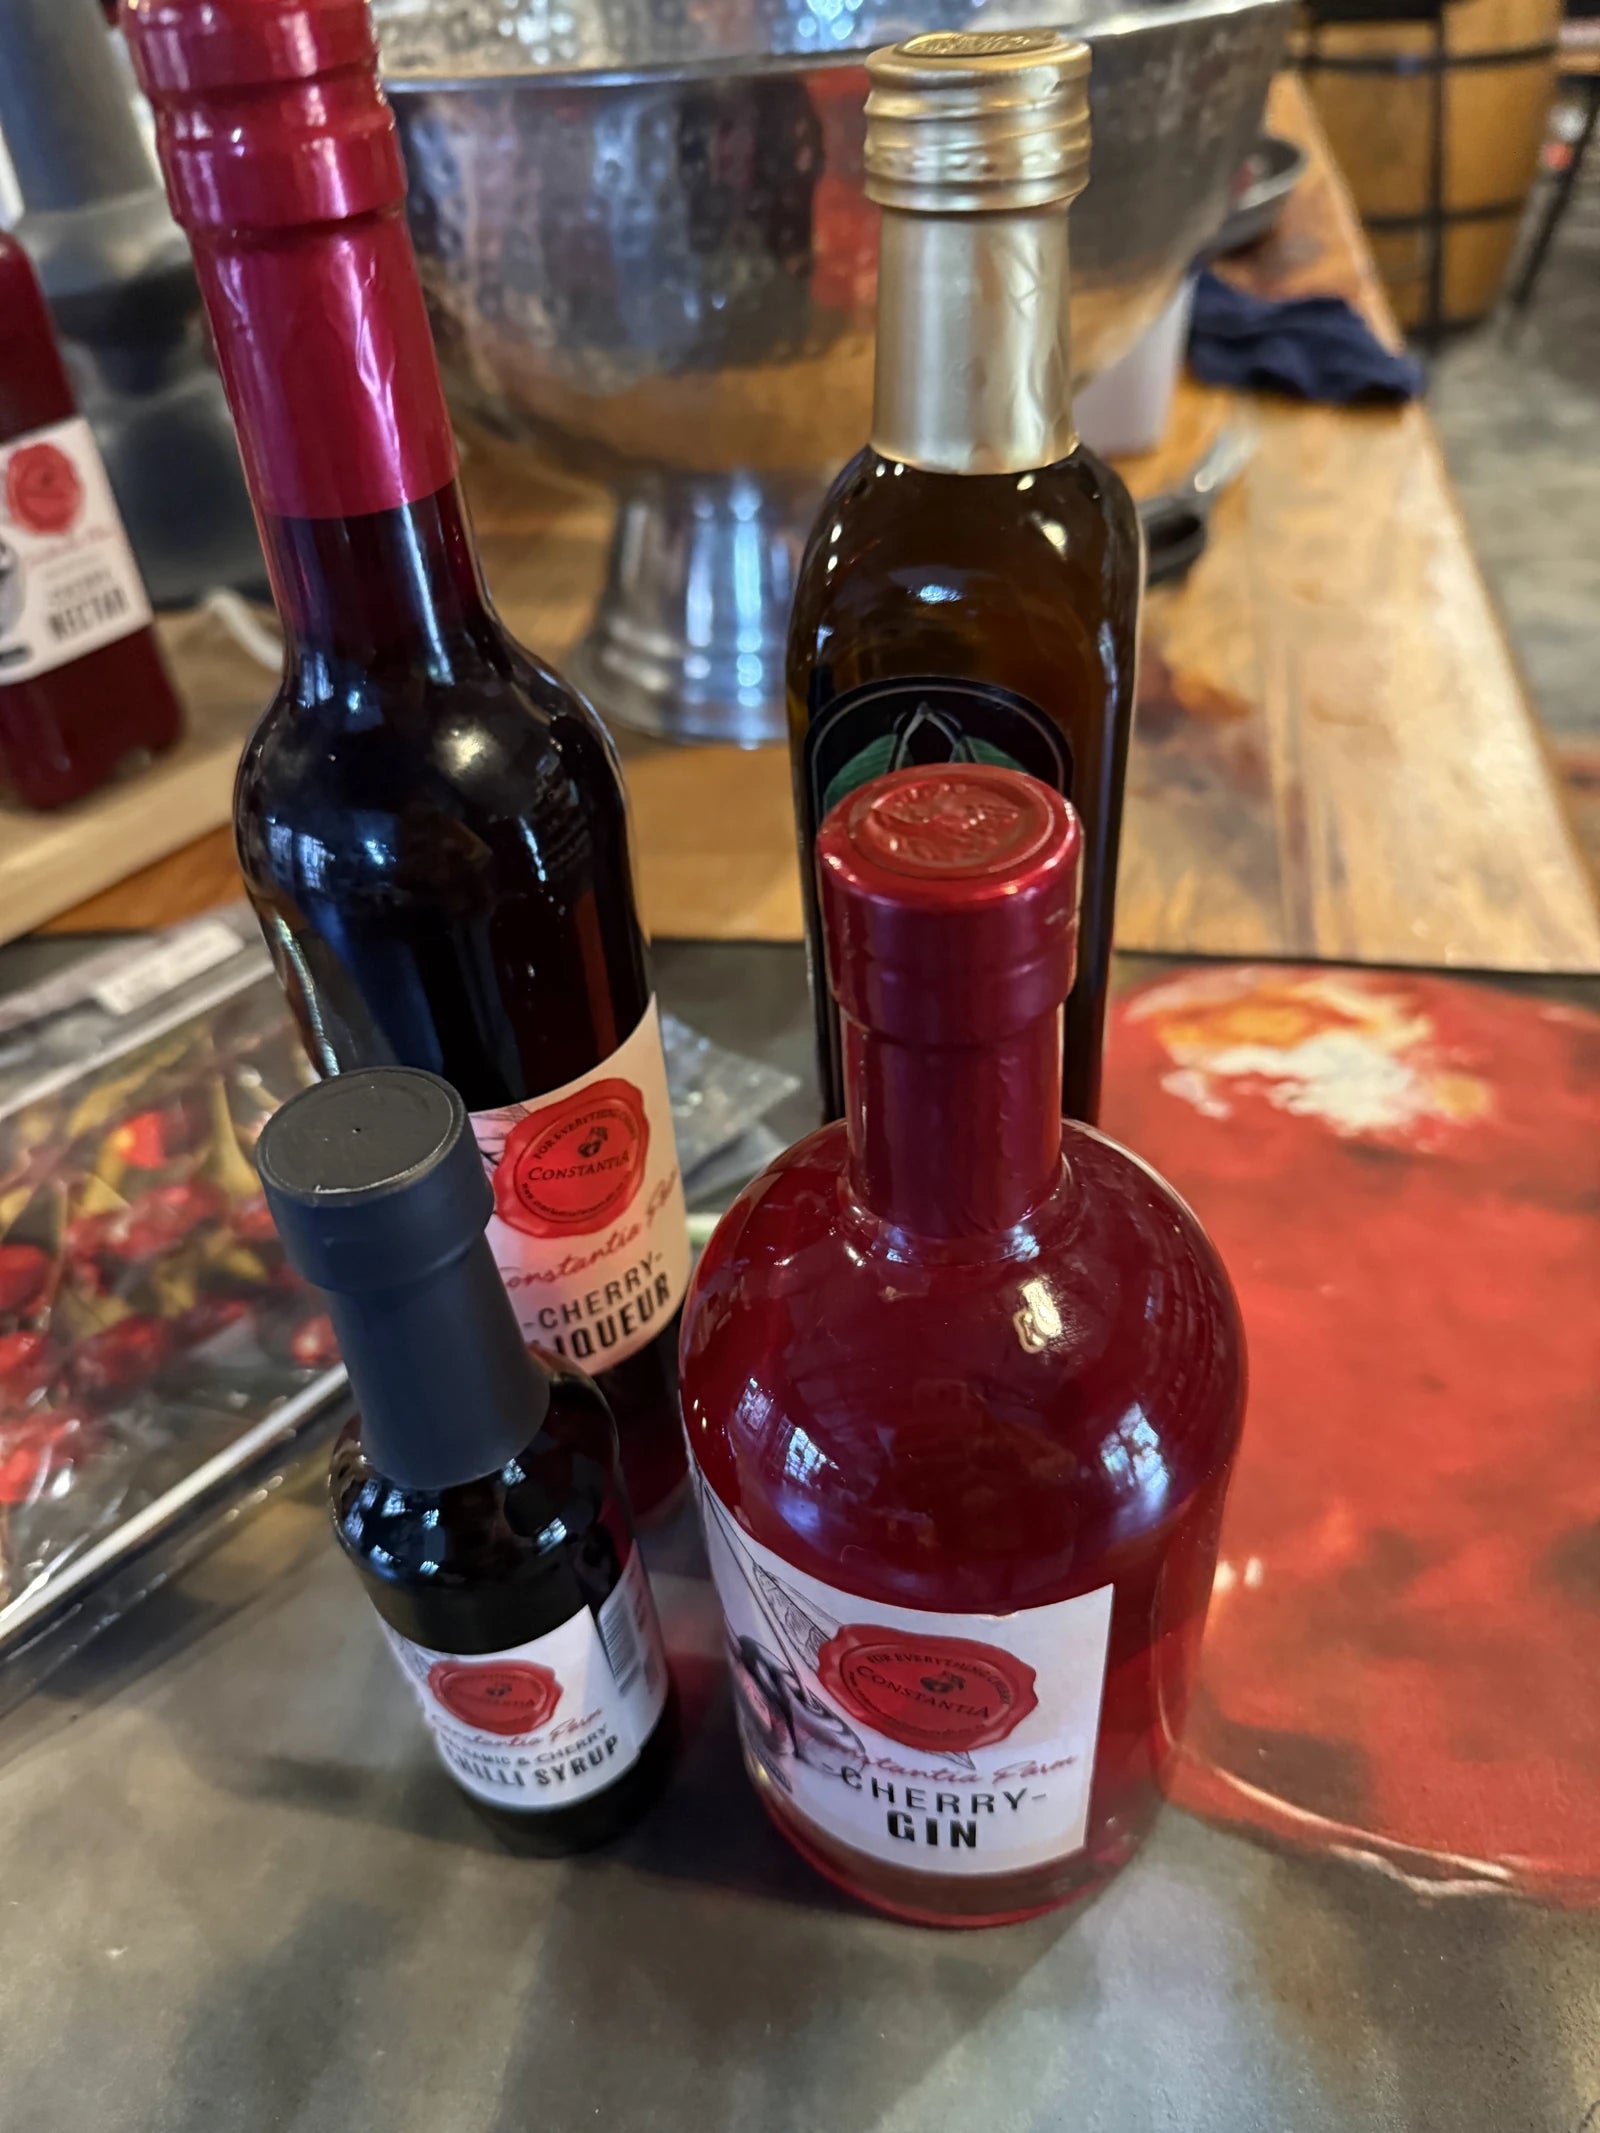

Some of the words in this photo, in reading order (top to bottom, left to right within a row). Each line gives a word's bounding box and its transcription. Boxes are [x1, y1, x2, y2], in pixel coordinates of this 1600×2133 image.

[528, 1151, 630, 1181] CONSTANTIA
[542, 1271, 670, 1359] IQUEUR
[856, 1665, 990, 1719] CONSTANTIA
[534, 1734, 619, 1786] SYRUP
[536, 1722, 608, 1763] CHERRY
[887, 1810, 977, 1848] GIN
